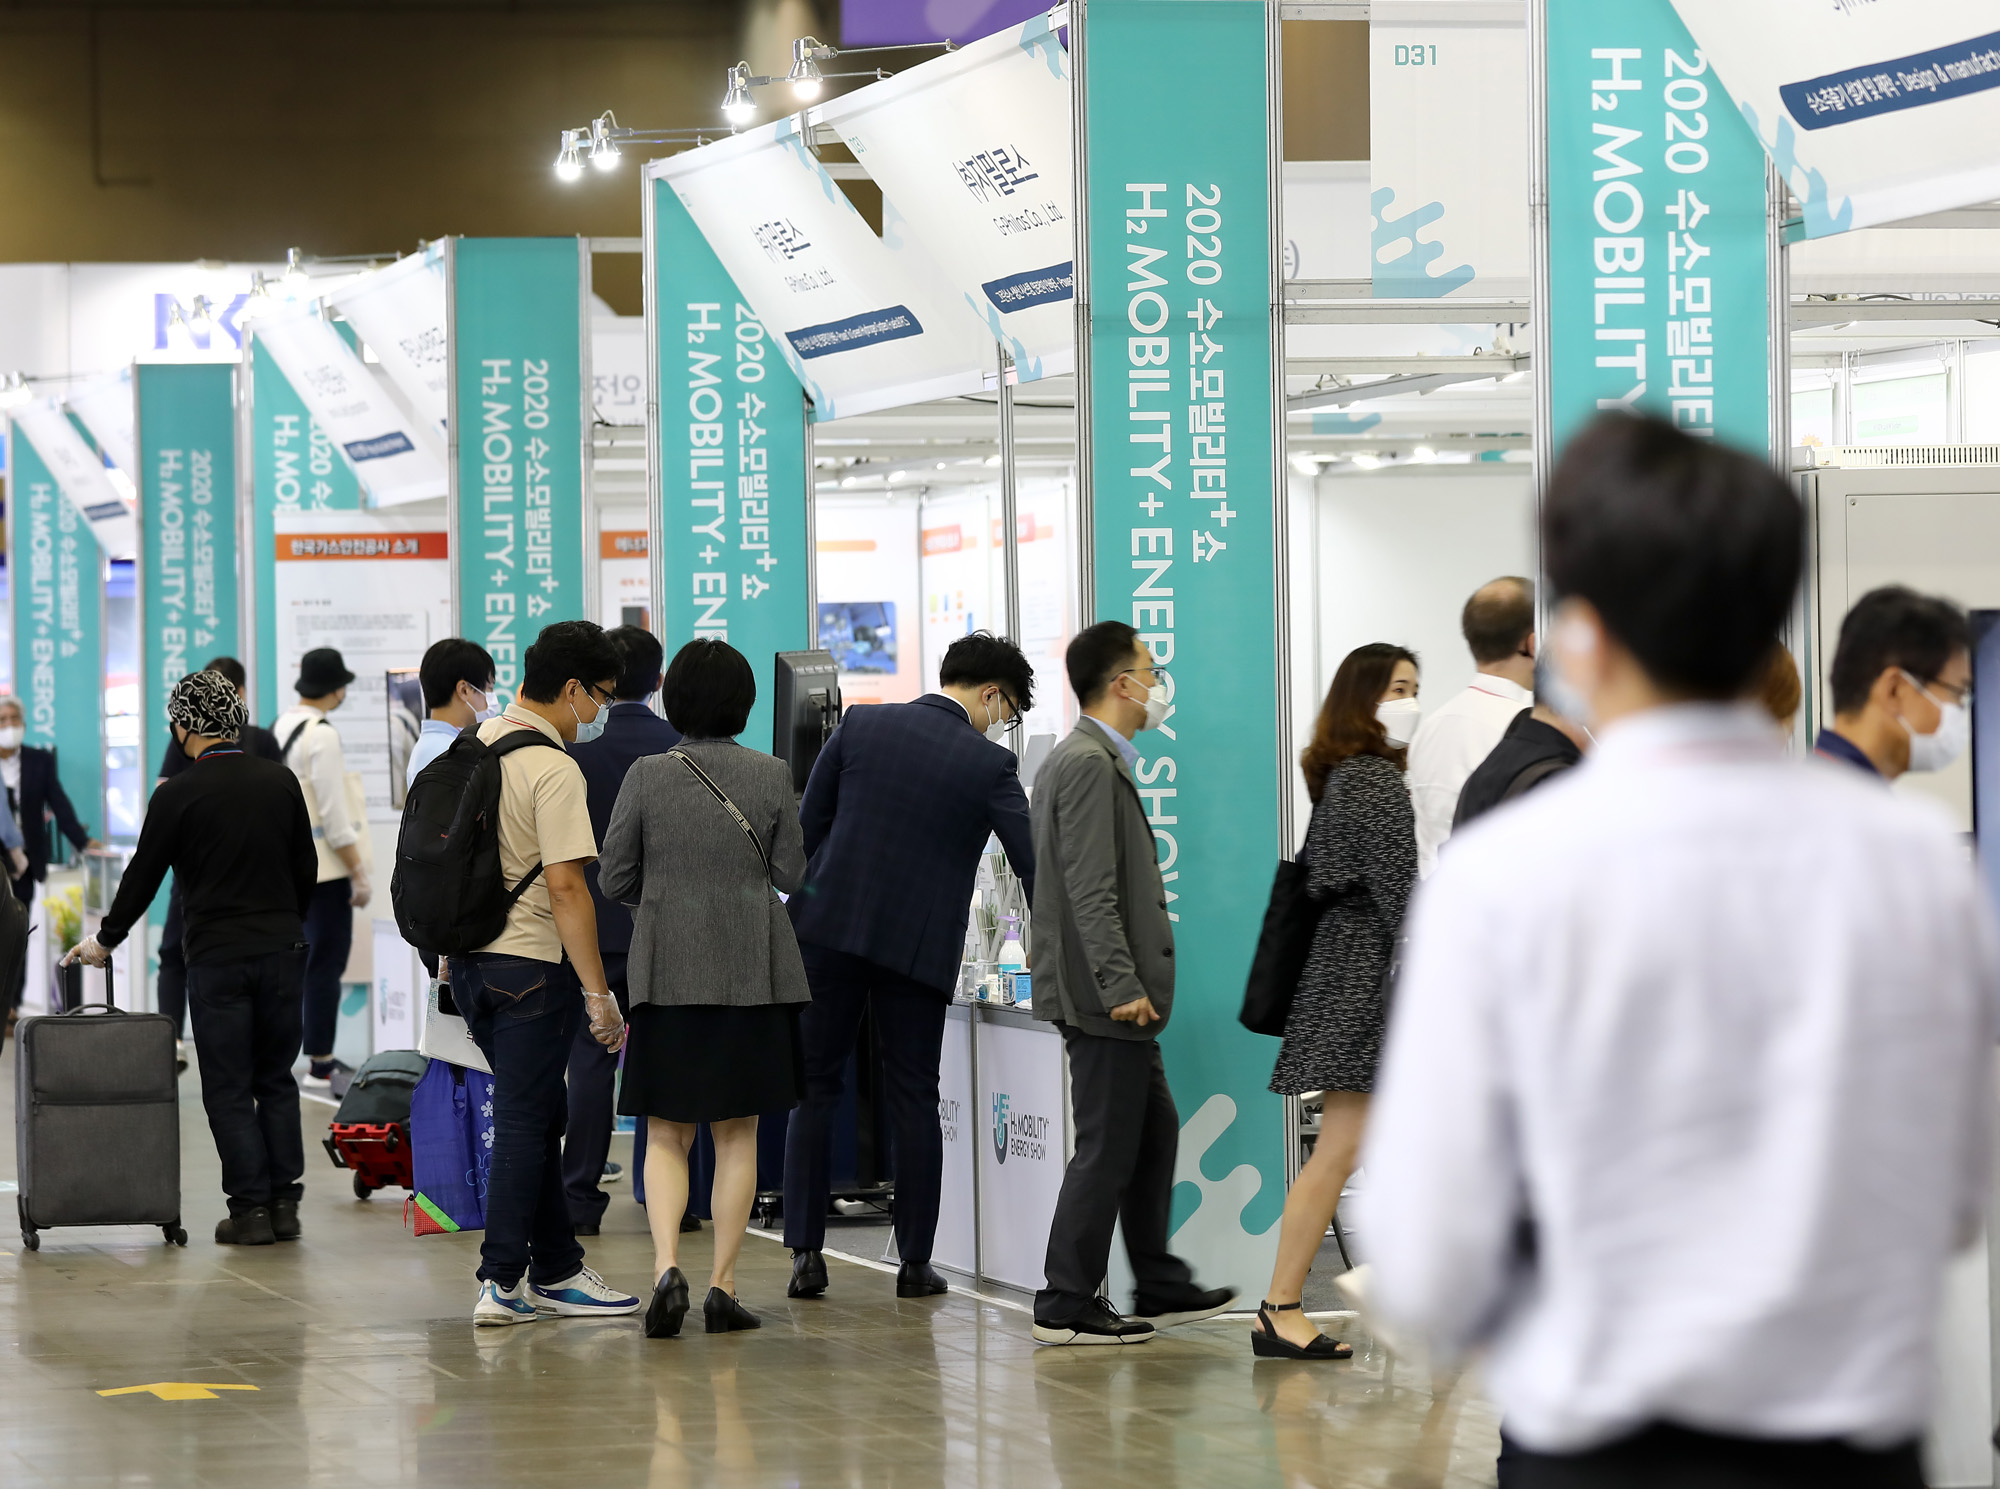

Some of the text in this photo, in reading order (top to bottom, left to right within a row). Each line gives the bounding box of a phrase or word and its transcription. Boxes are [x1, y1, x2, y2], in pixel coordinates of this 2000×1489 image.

[1394, 45, 1438, 66] D31
[1896, 67, 1940, 92] Design
[1932, 62, 1950, 83] &
[1664, 47, 1709, 174] 2020
[1186, 184, 1222, 285] 2020
[735, 302, 766, 383] 2020
[523, 359, 550, 429] 2020
[191, 449, 213, 505] 2020
[392, 538, 420, 555] 소개
[1192, 530, 1227, 563] 쇼
[742, 573, 770, 600] 쇼
[527, 594, 552, 618] 쇼
[1010, 1138, 1047, 1162] ENERGY SHOW
